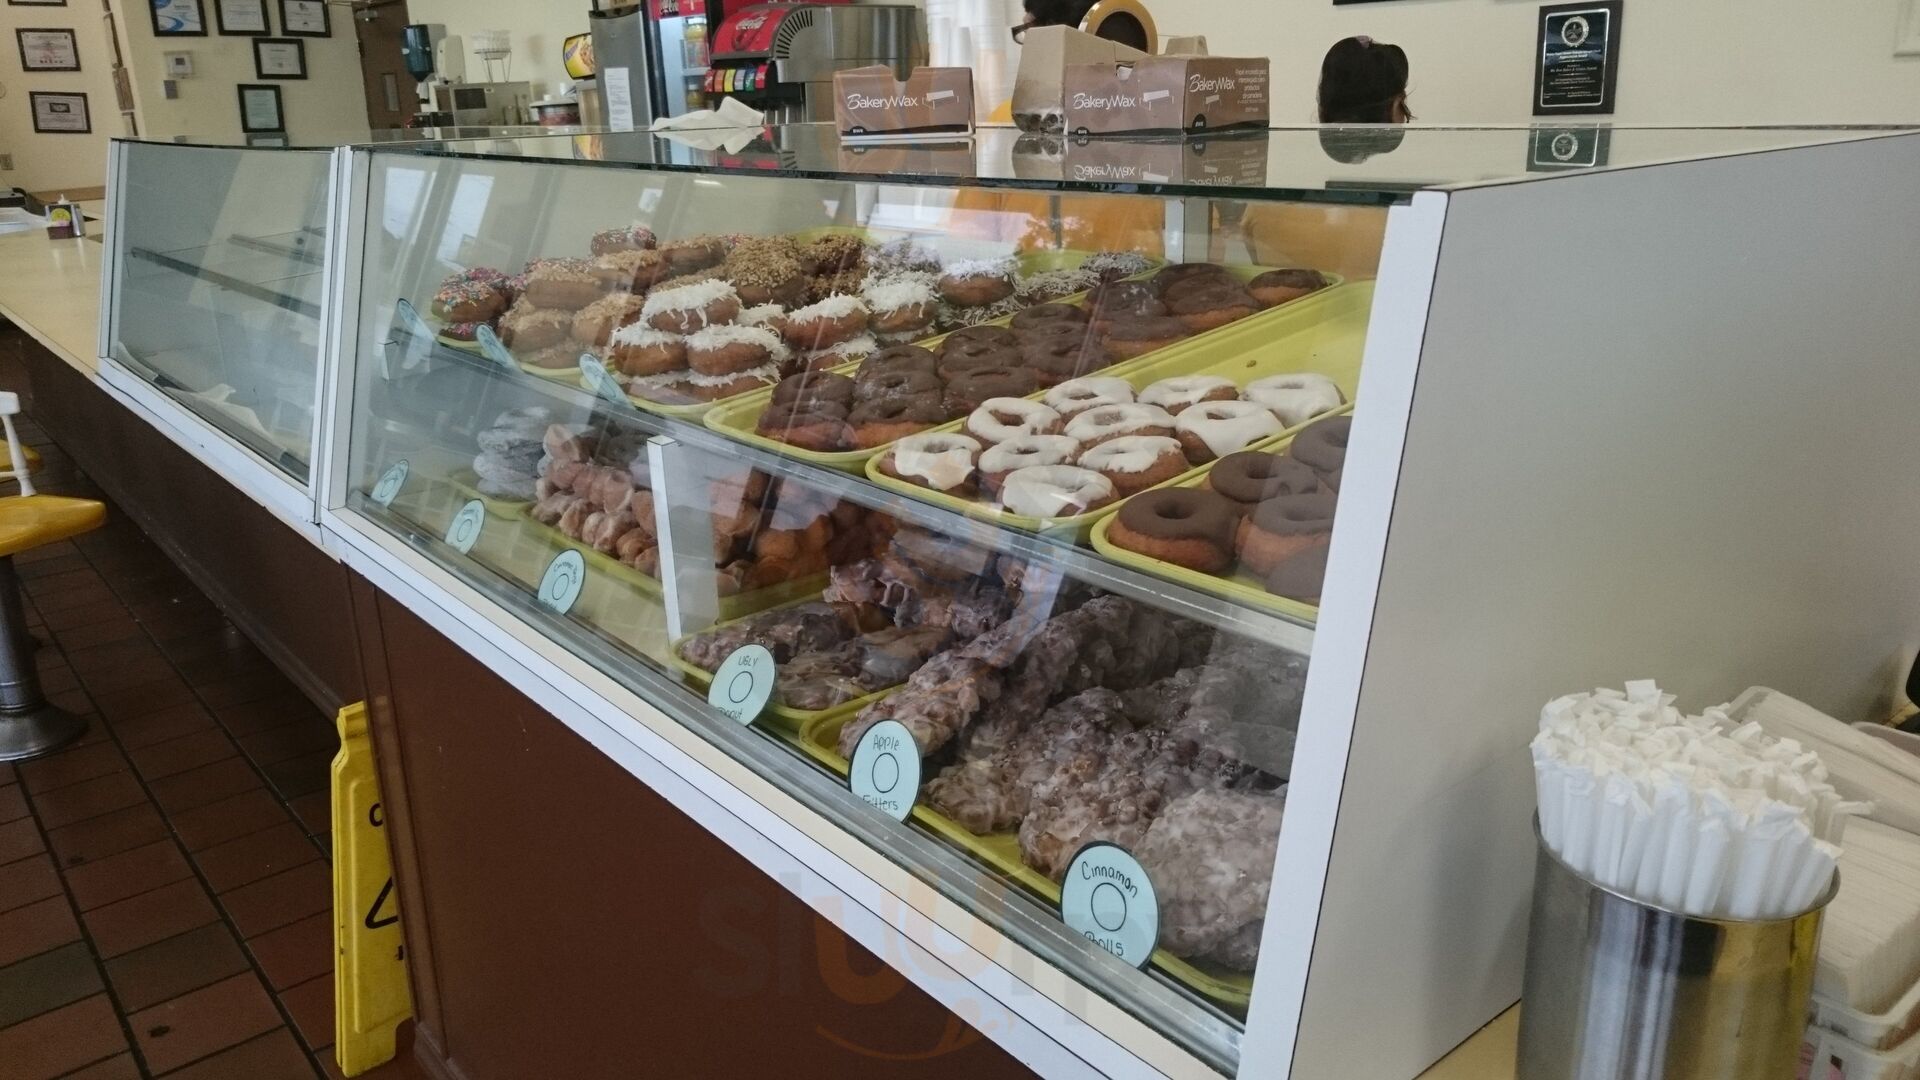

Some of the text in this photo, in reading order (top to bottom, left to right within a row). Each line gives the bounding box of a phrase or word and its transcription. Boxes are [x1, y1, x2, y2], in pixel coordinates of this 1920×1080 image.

[1189, 74, 1235, 93] BakeryWax
[847, 93, 918, 110] BakeryWax
[1073, 93, 1136, 110] BakeryWax
[738, 655, 758, 667] UGLY
[873, 735, 900, 751] Apple
[1081, 861, 1138, 898] Cinnamon
